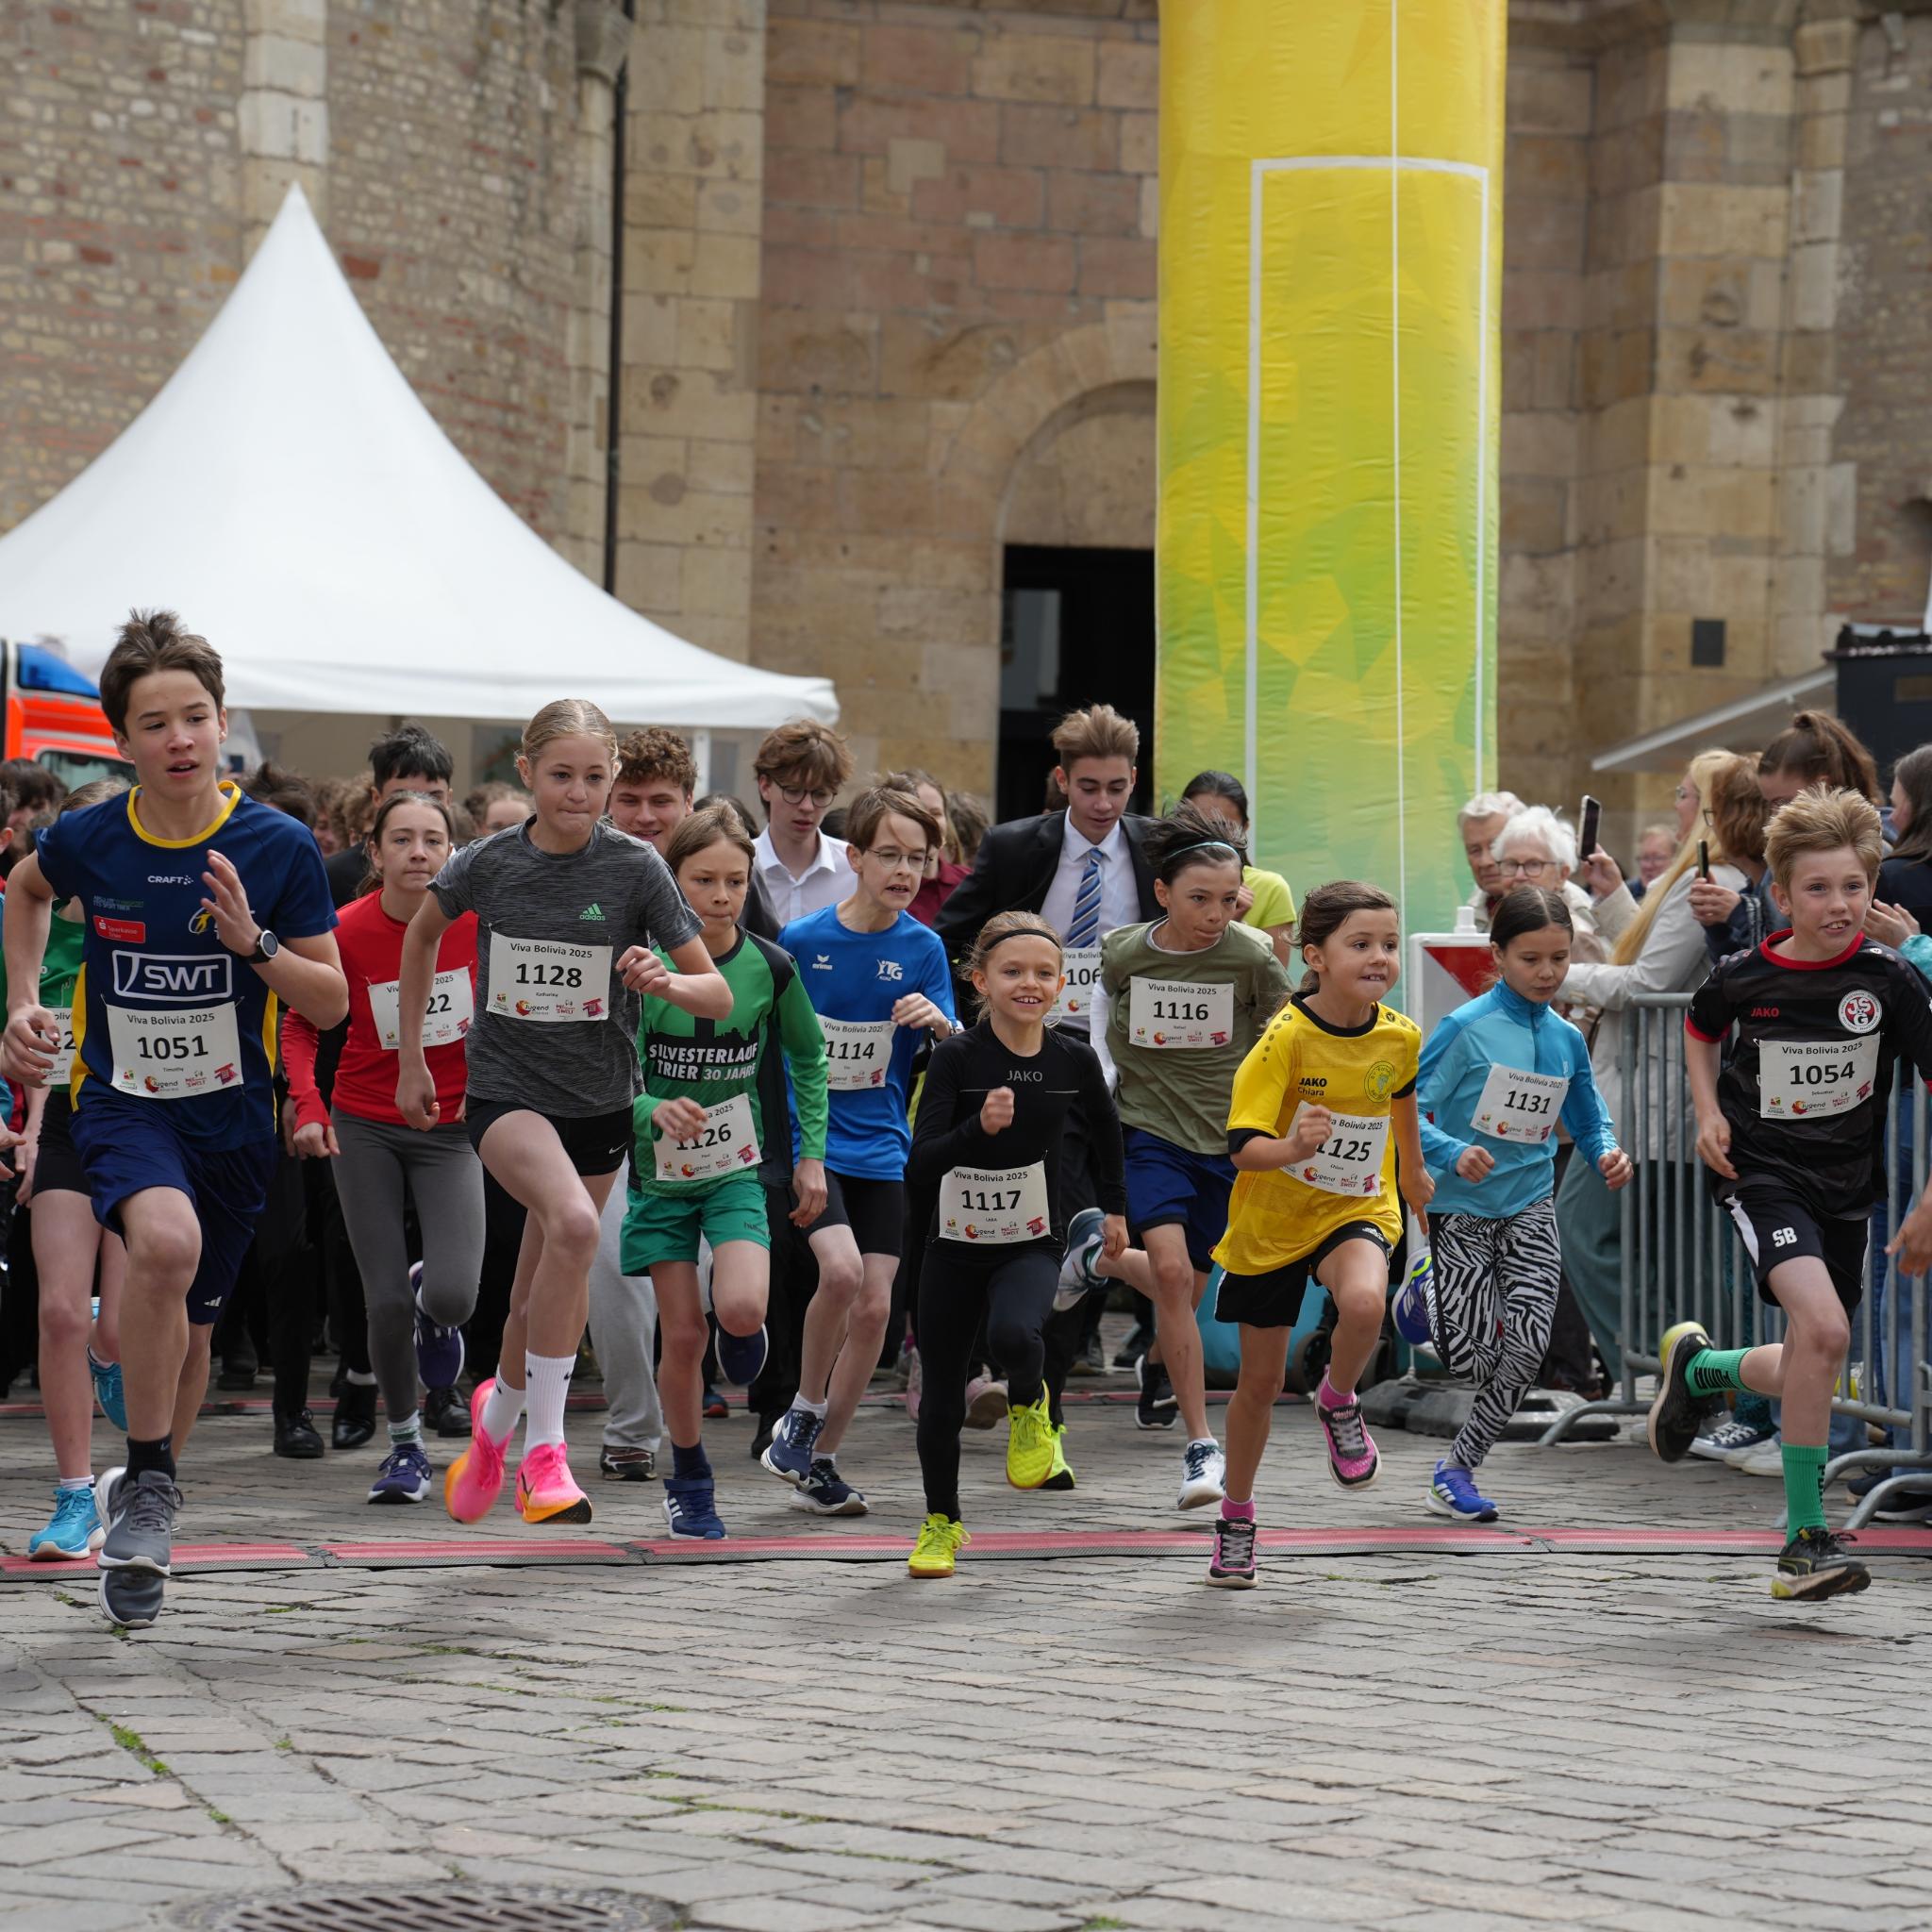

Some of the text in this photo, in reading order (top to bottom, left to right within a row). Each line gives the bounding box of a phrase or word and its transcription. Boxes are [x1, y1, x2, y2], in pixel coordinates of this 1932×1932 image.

[148, 875, 183, 884] CRAFT
[510, 943, 592, 958] Viva Bolivia 2025
[144, 964, 219, 991] SWT
[515, 963, 582, 989] 1128
[1148, 983, 1217, 995] Viva Bolivia 2025
[126, 1012, 215, 1025] Viva Bolivia 2025
[1153, 1001, 1209, 1021] 1116
[1751, 1007, 1780, 1018] JAKO
[824, 1022, 841, 1032] Viva
[868, 1024, 883, 1033] 2025
[137, 1035, 208, 1060] 1051
[649, 1041, 758, 1064] SILVESTERLAUF
[825, 1041, 874, 1060] 1114
[1782, 1041, 1863, 1055] Viva Bolivia 2025
[657, 1058, 756, 1081] TRIER 30 JAHRE
[1007, 1070, 1042, 1082] JAKO
[1790, 1060, 1855, 1085] 1054
[1299, 1077, 1327, 1088] JAKO
[1509, 1072, 1524, 1082] Viva
[1524, 1075, 1548, 1087] Bolivia
[1297, 1087, 1324, 1096] Chiara
[715, 1104, 734, 1116] 2025
[1504, 1091, 1551, 1114] 1131
[1340, 1119, 1366, 1130] Bolivia
[1368, 1122, 1383, 1130] 2025
[954, 1171, 1028, 1182] Viva Bolivia 2025
[961, 1190, 1021, 1211] 1117
[1773, 1226, 1797, 1247] SB
